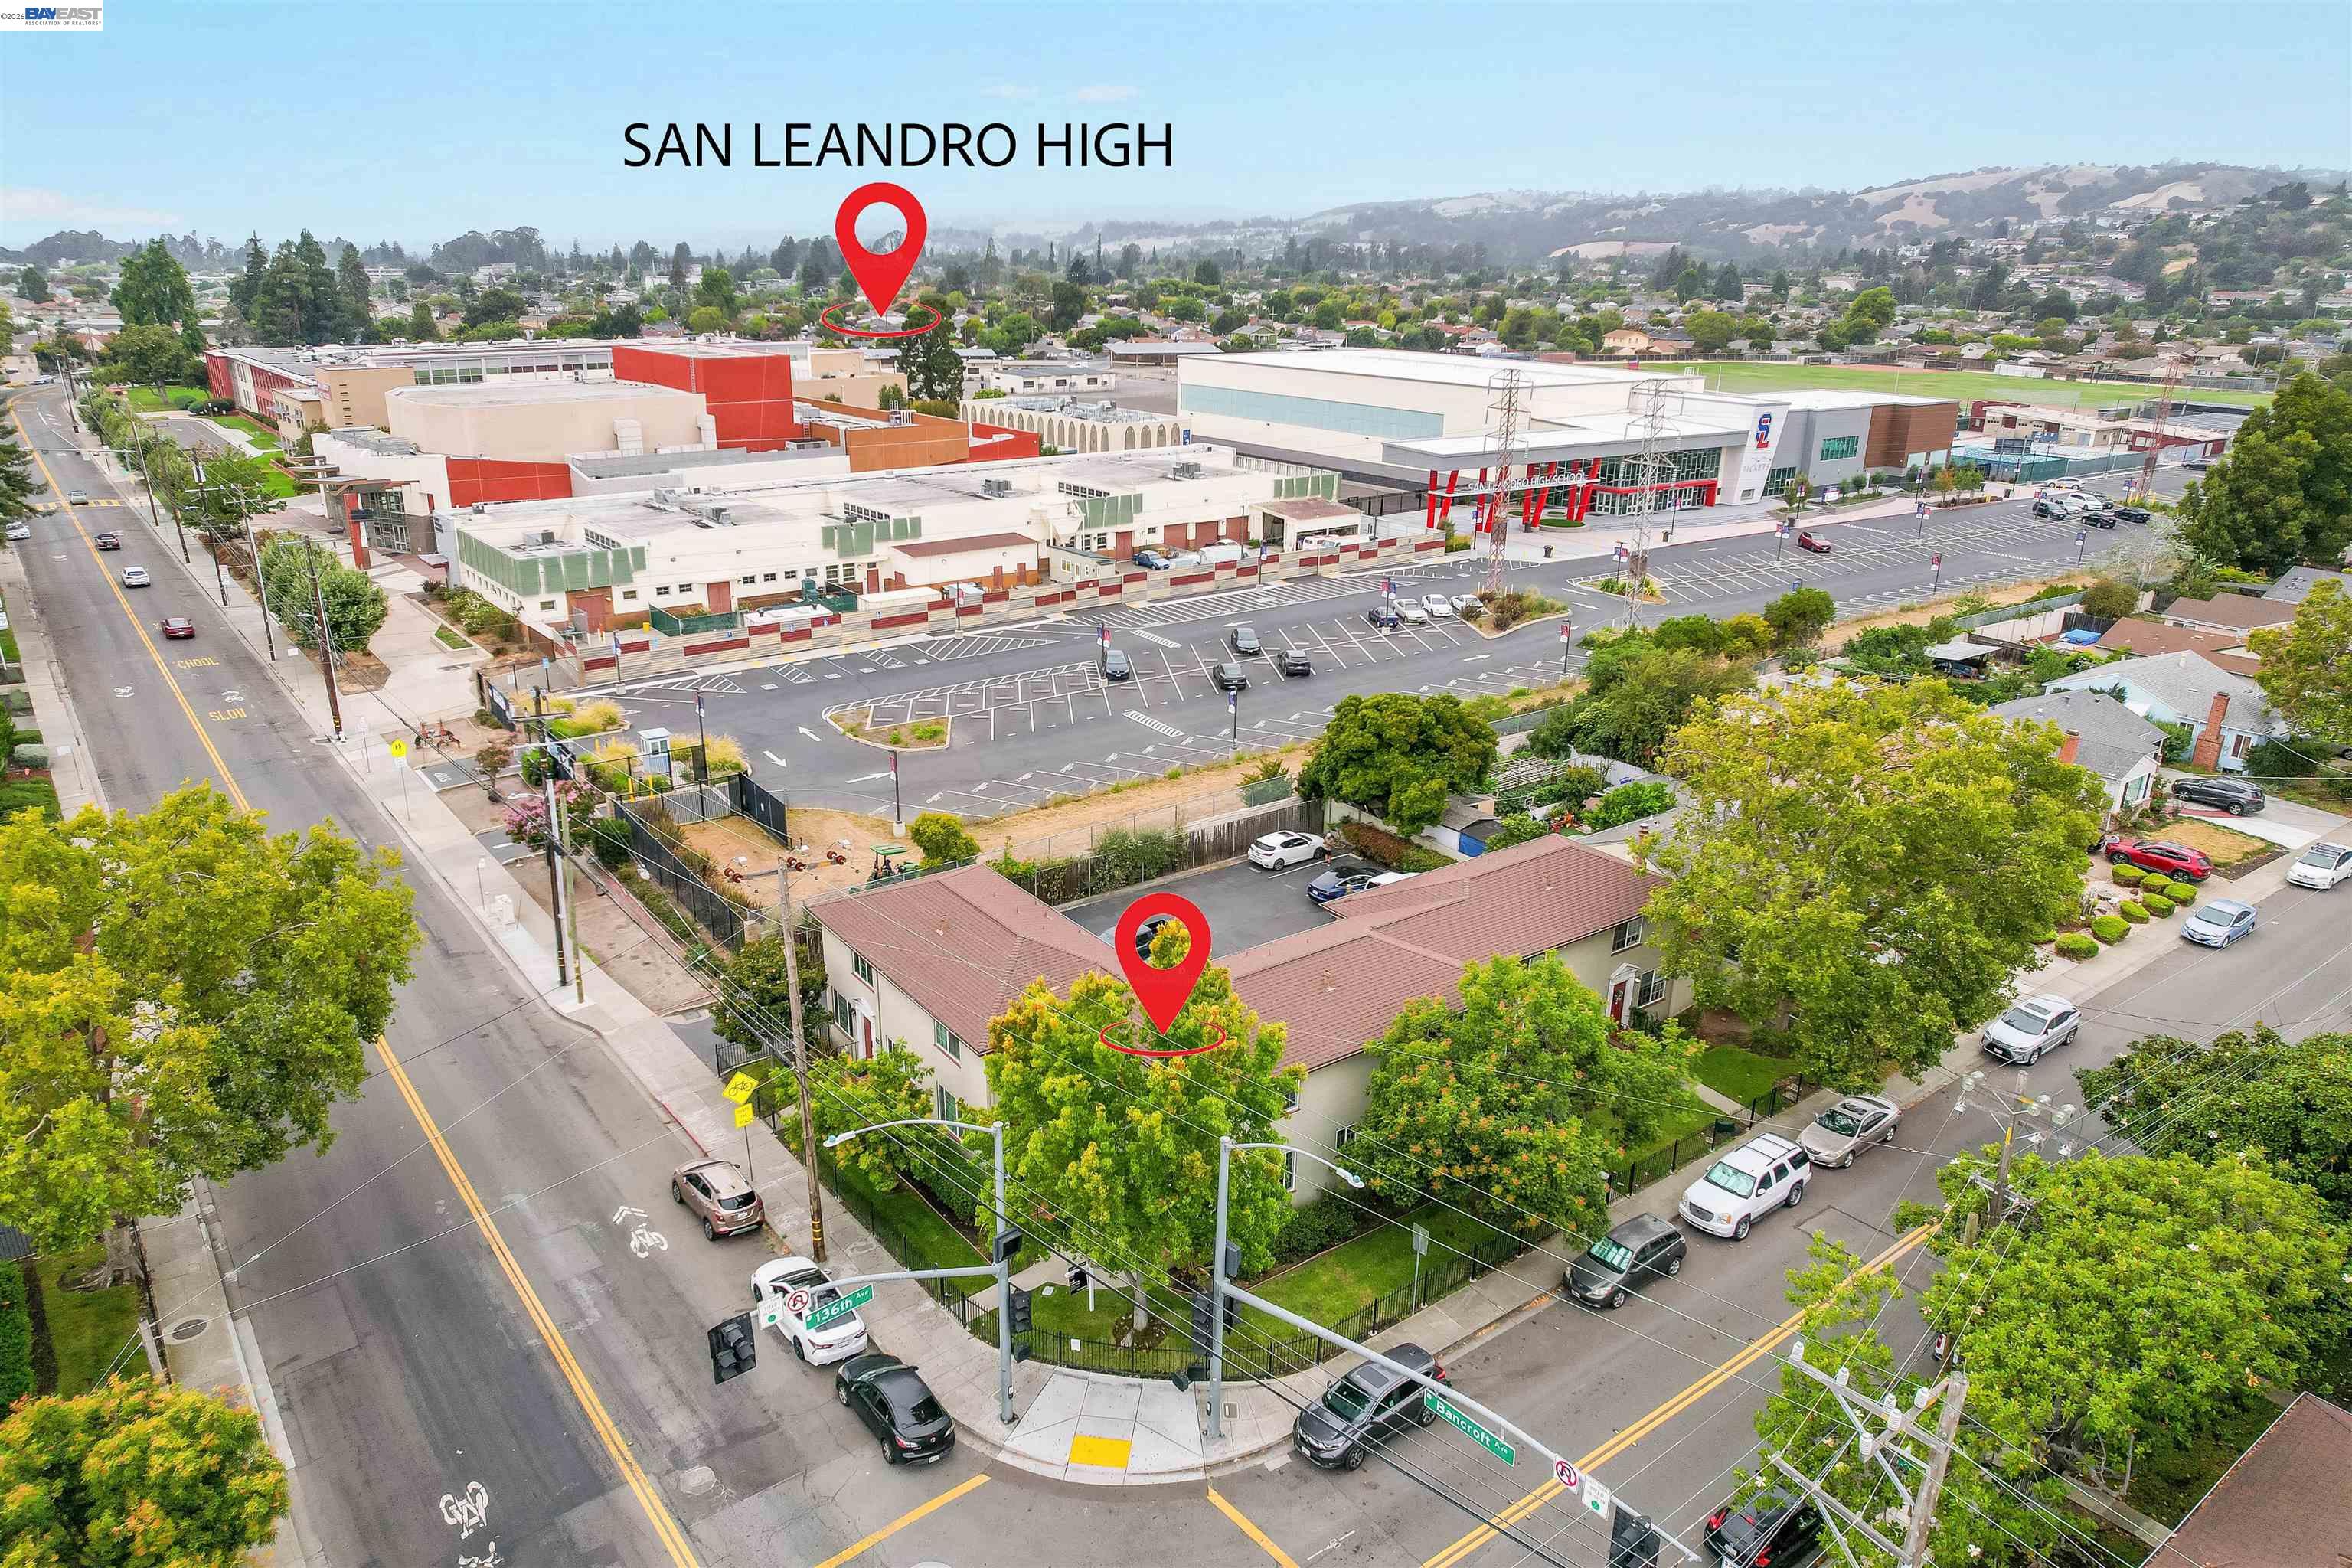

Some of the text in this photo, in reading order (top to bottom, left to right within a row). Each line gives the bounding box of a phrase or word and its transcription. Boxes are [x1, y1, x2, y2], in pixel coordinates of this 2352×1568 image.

[1468, 482, 1487, 491] SAN
[1530, 475, 1552, 486] HIGH
[1552, 472, 1585, 485] SCHOOL
[815, 1297, 853, 1324] 136th
[1436, 1400, 1491, 1447] Bancroft
